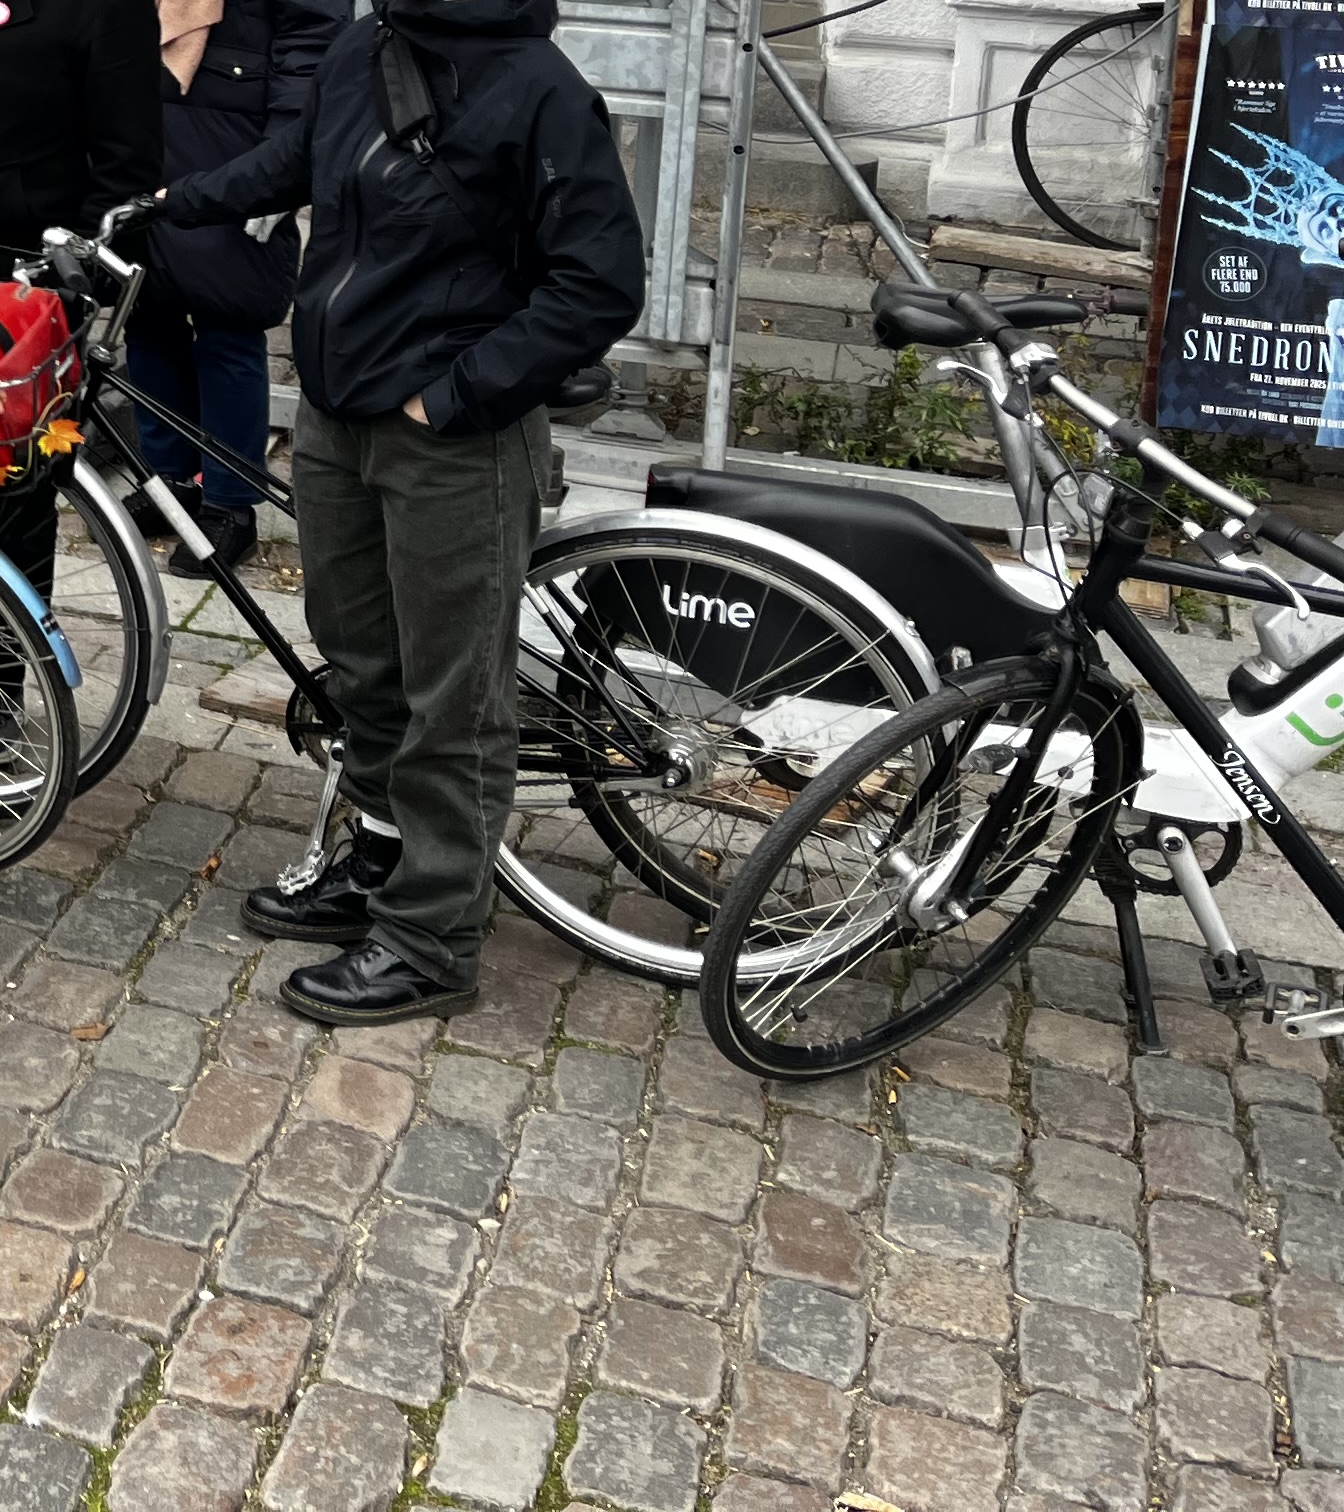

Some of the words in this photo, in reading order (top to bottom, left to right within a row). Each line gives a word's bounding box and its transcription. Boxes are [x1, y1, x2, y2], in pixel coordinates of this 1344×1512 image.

[1219, 255, 1236, 268] SET
[1238, 255, 1249, 268] AF
[1210, 268, 1238, 281] FLERE
[1239, 268, 1259, 281] END
[1219, 281, 1251, 293] 75.000
[1209, 742, 1281, 825] Jensen
